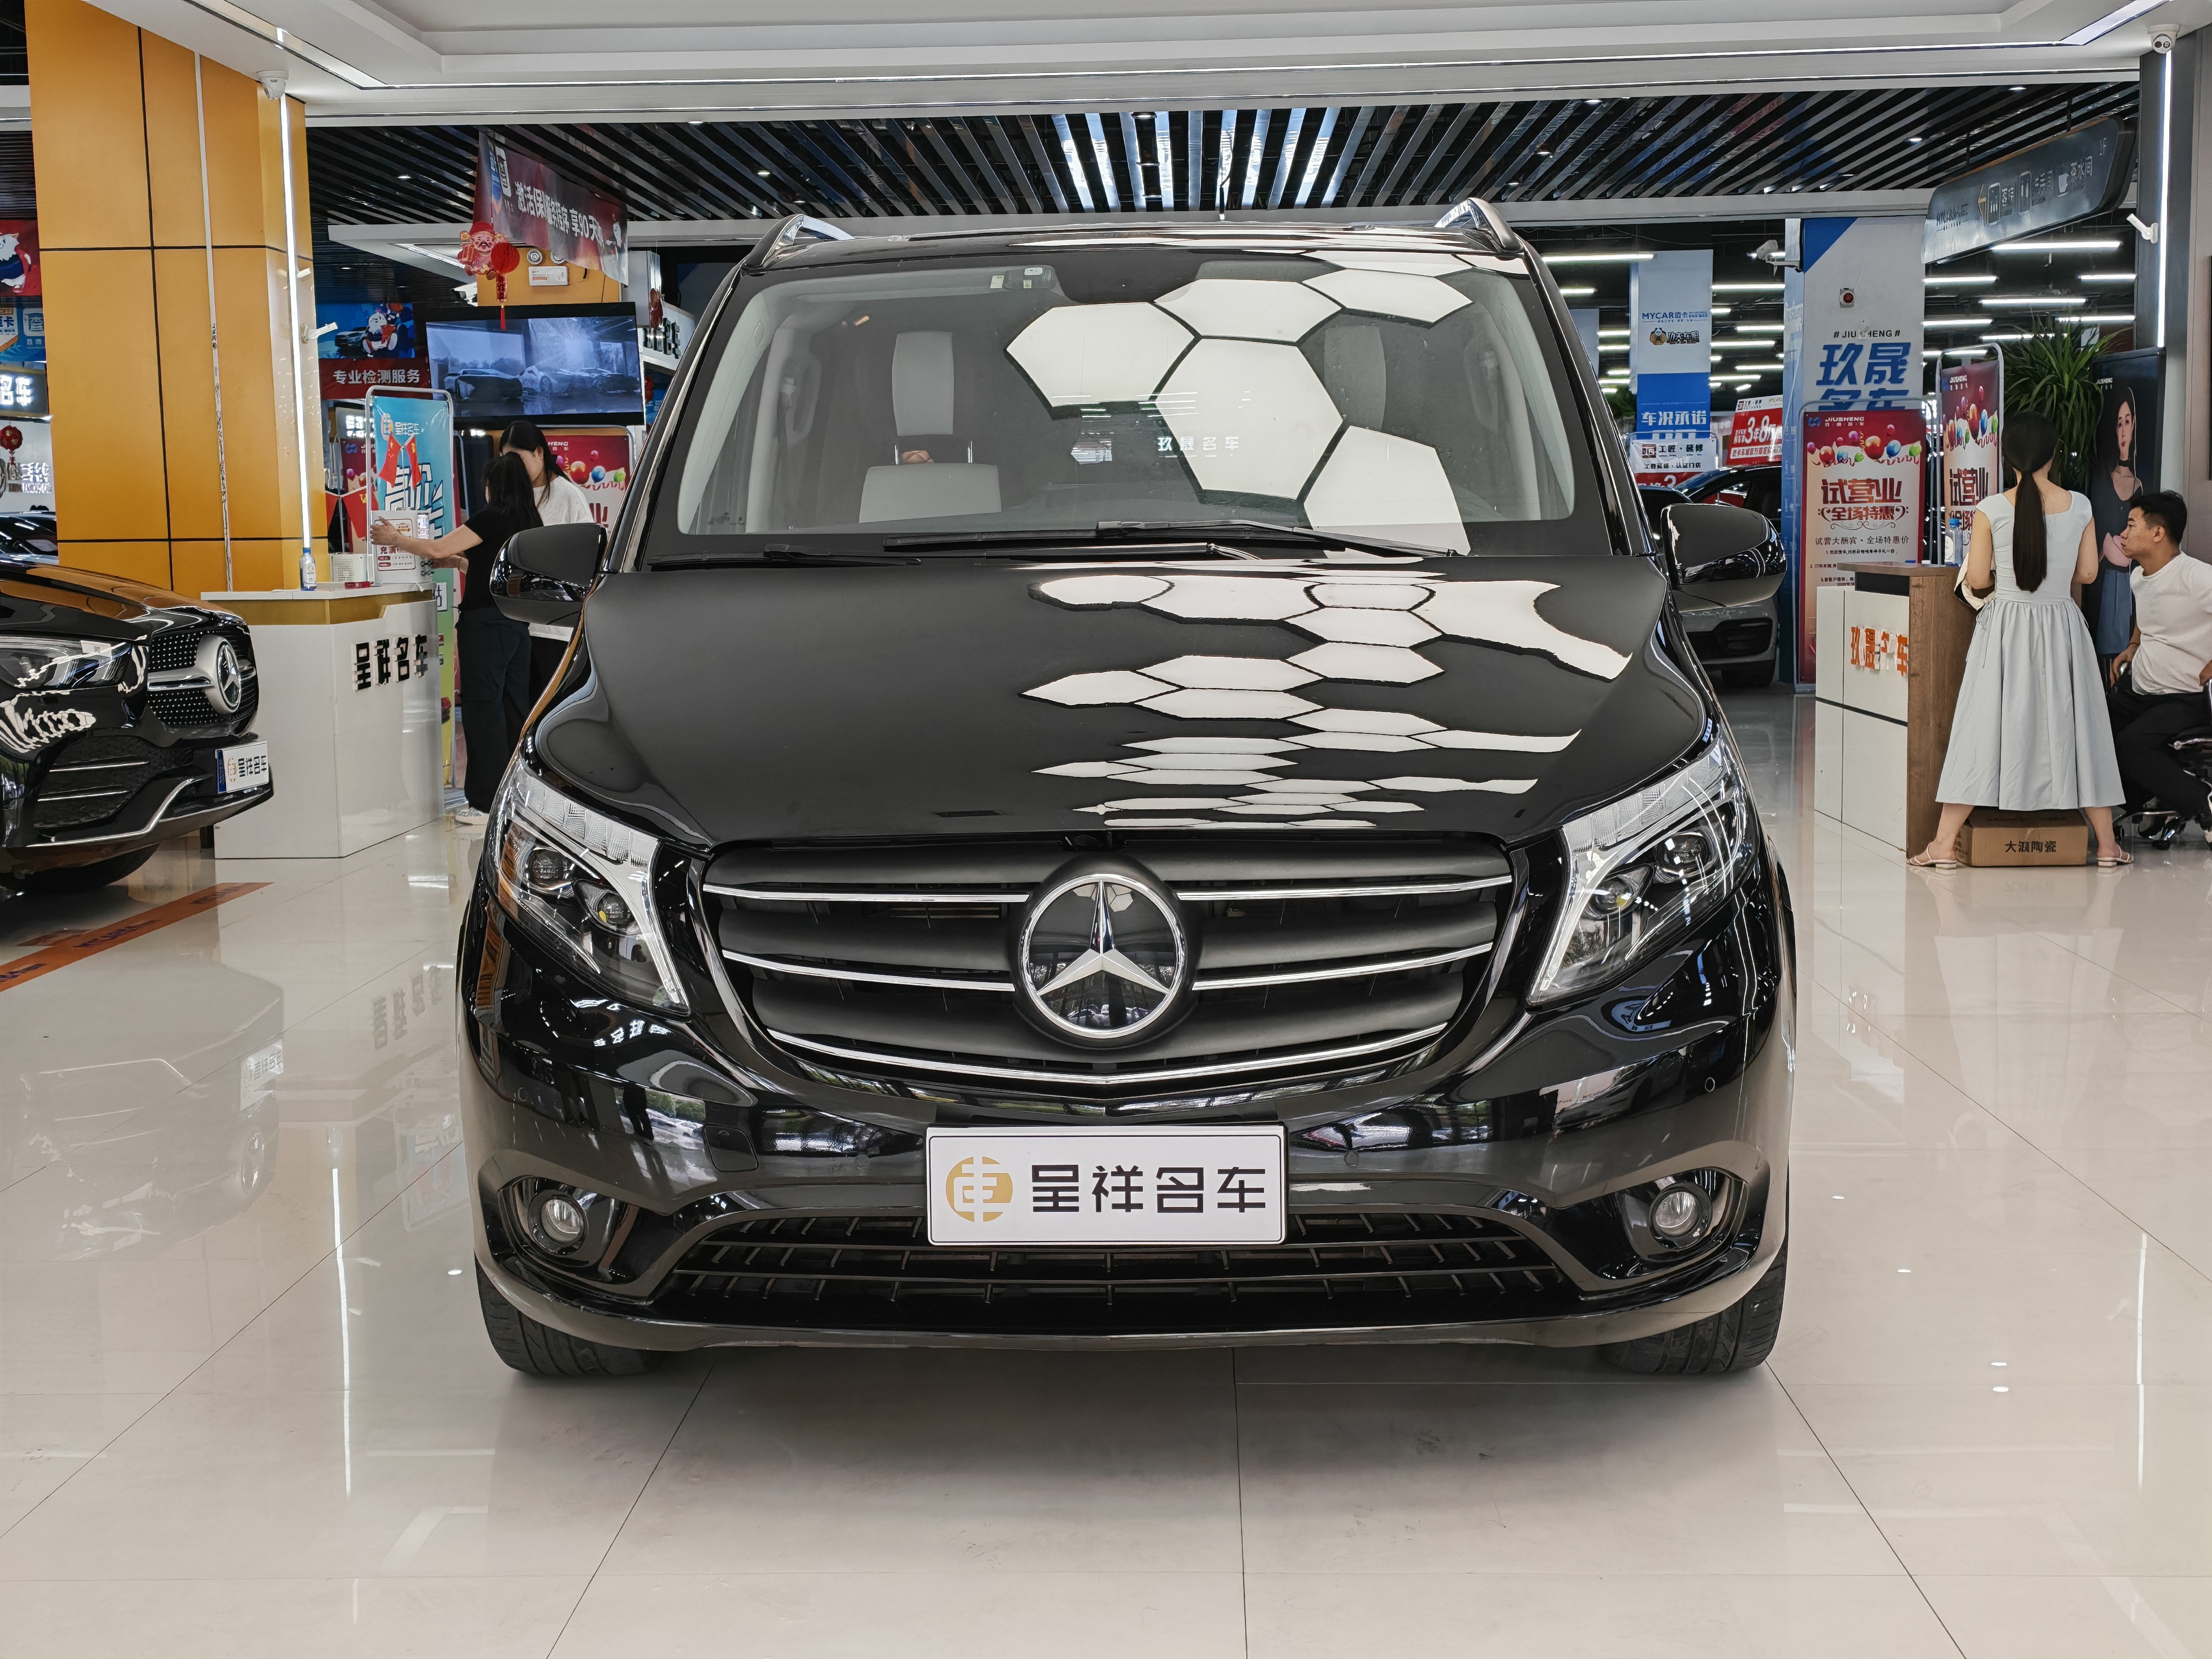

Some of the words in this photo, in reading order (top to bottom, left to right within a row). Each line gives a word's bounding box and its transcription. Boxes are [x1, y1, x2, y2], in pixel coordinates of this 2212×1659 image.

[2071, 156, 2093, 182] 茶水间
[333, 369, 420, 384] 专业检测服务
[1816, 342, 1911, 385] 玖晟
[1641, 410, 1707, 426] 车况承诺
[1821, 477, 1902, 504] 试营业
[1831, 506, 1895, 521] 全场特惠
[351, 634, 428, 691] 呈祥名车
[238, 755, 267, 777] 呈祥名车
[1031, 1164, 1266, 1213] 呈祥名车
